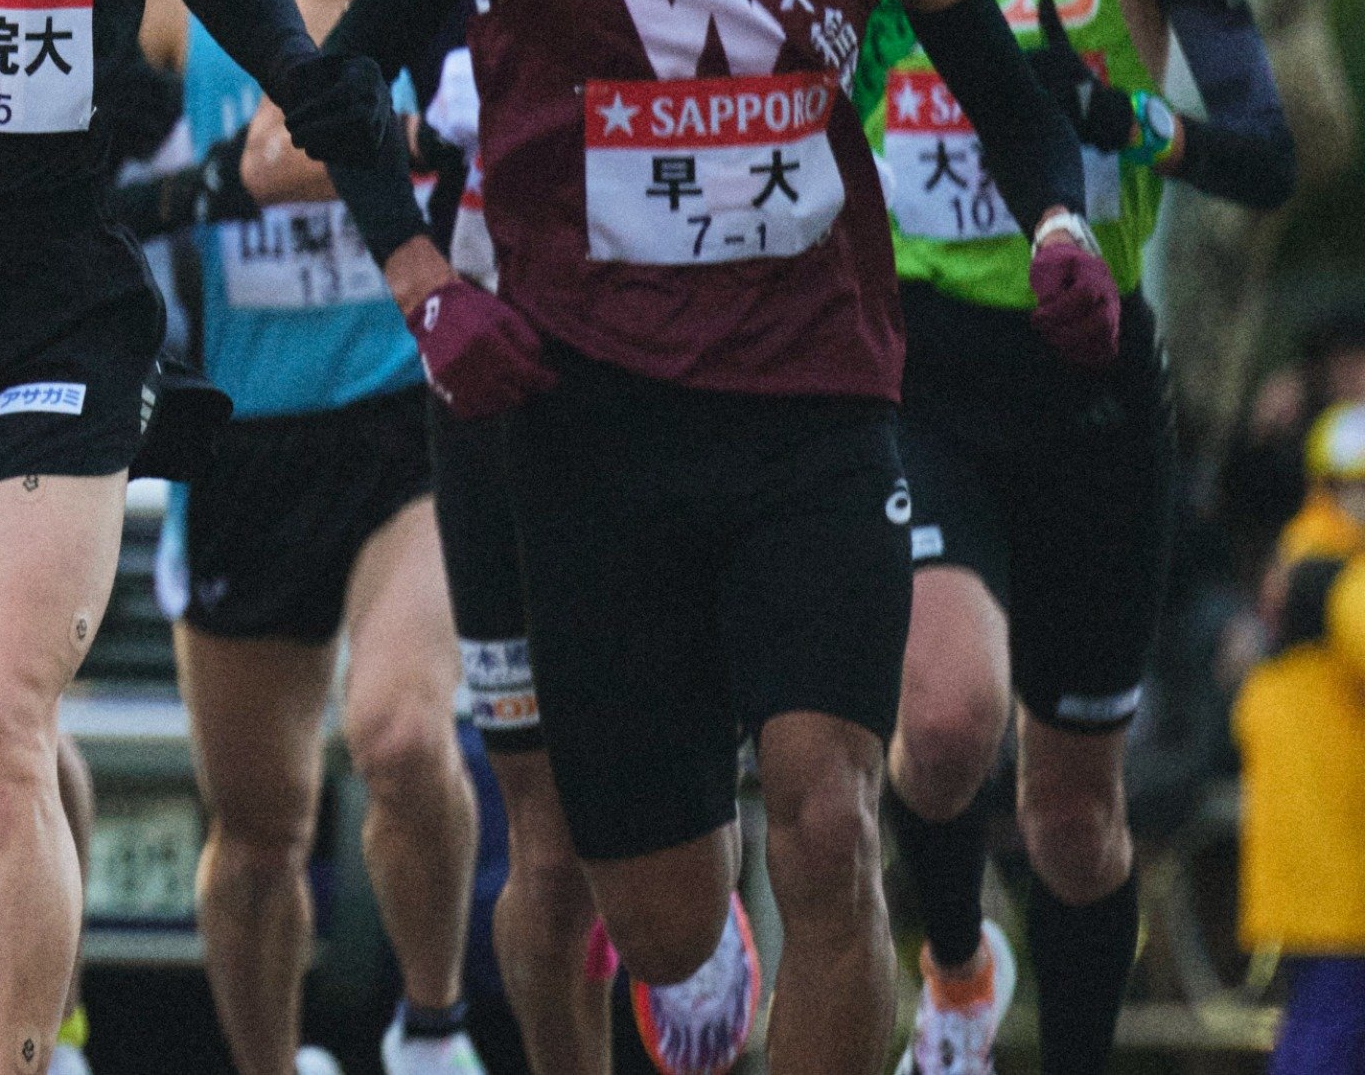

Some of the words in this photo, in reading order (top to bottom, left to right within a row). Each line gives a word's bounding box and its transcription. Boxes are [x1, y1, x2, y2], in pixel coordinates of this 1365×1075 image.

[650, 84, 830, 138] SAPPORO
[645, 150, 801, 213] 早大
[687, 217, 768, 258] 7-1
[0, 388, 81, 409] アサガミ
